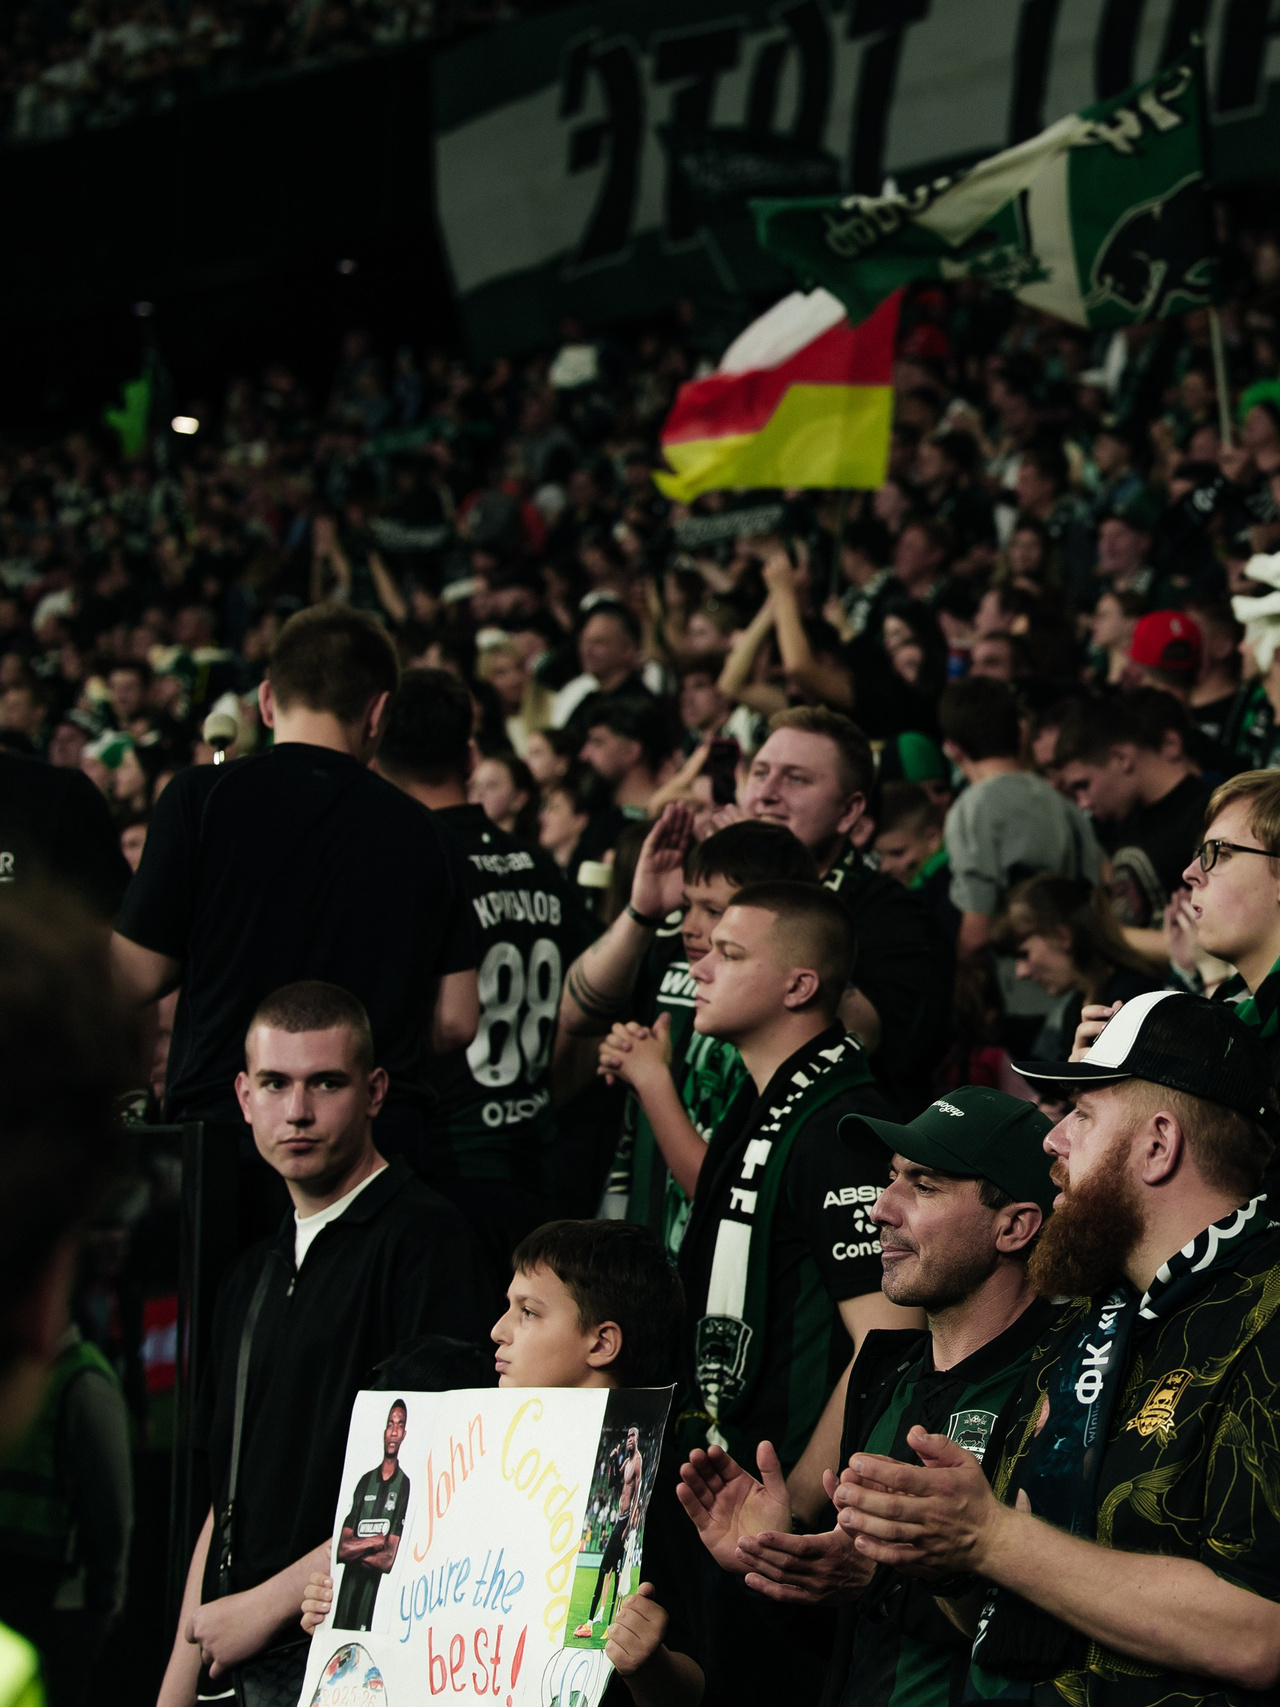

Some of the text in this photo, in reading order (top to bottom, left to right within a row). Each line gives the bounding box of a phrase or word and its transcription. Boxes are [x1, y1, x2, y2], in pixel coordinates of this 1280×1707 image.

[465, 937, 563, 1088] 88
[832, 1239, 883, 1261] Cons
[413, 1398, 581, 1643] John Cordoba
[472, 1548, 525, 1614] the
